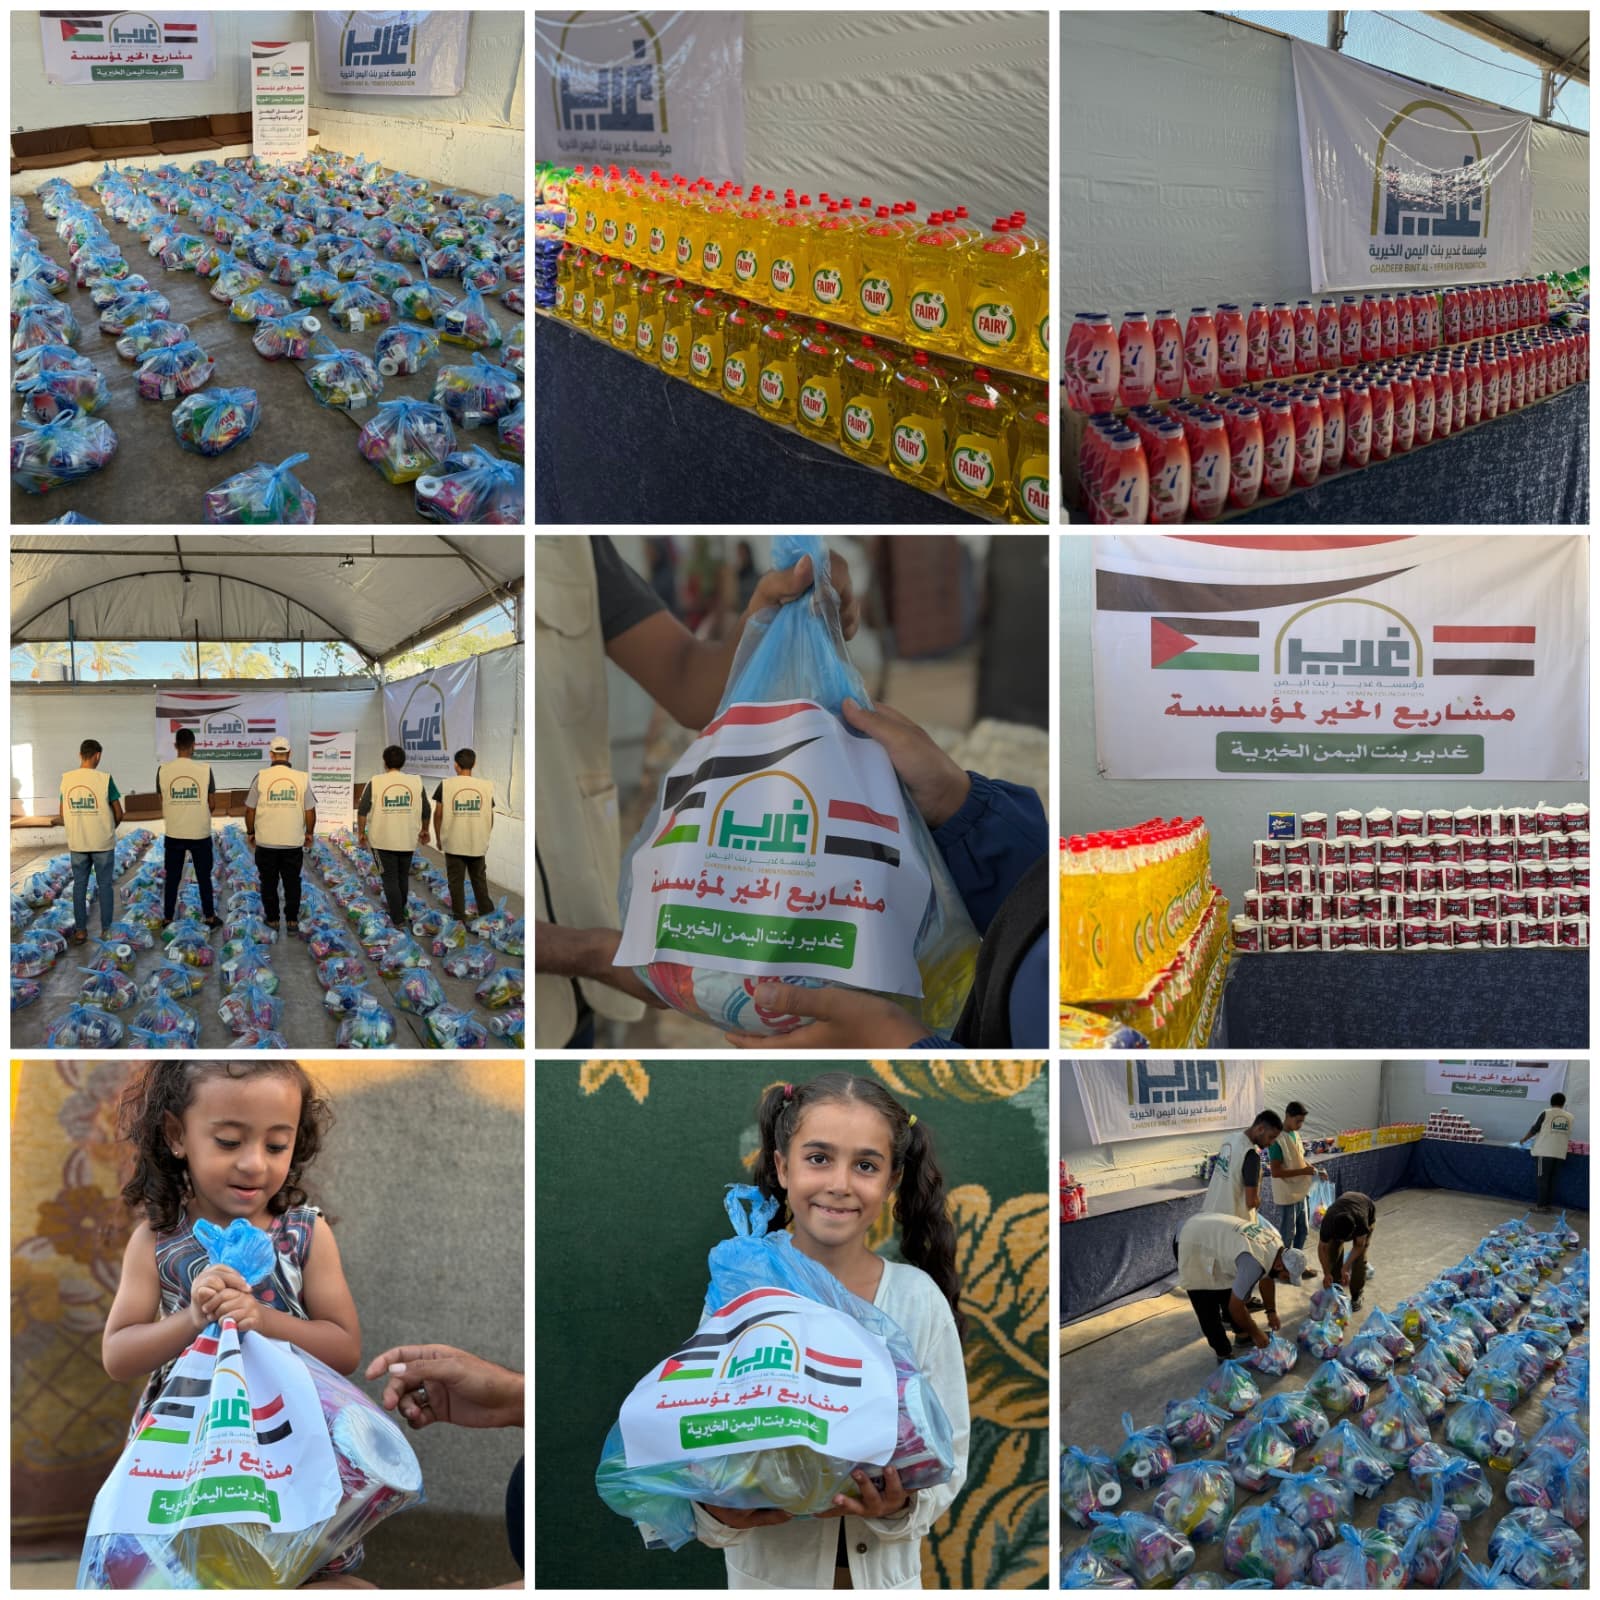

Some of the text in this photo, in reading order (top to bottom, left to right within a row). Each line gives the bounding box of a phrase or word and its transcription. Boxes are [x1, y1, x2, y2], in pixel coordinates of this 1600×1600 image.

[114, 24, 157, 43] غدير
[71, 50, 192, 63] مشاريع الخير لمؤسسة
[560, 39, 654, 132] غدير
[632, 138, 672, 157] مؤسسة
[1385, 155, 1482, 237] غدير
[704, 252, 718, 264] FAIRY
[1369, 243, 1488, 260] مؤسسة غدير بنت اليمن الخيرية
[738, 260, 752, 273] FAIRY
[1370, 263, 1404, 274] GHADEER
[1404, 264, 1420, 272] BINT
[1421, 263, 1429, 272] AL
[774, 269, 790, 284] FAIRY
[816, 279, 836, 294] FAIRY
[864, 290, 886, 306] FAIRY
[914, 302, 940, 322] FAIRY
[978, 316, 1008, 336] FAIRY
[693, 352, 706, 365] FAIRY
[726, 368, 742, 382] FAIRY
[762, 379, 778, 396] FAIRY
[803, 395, 822, 412] FAIRY
[847, 414, 868, 434] FAIRY
[898, 434, 920, 457] FAIRY
[958, 458, 986, 481] FAIRY
[1288, 626, 1410, 677] غدير
[1274, 680, 1424, 690] مؤسسة غدير بنت اليمن
[1164, 693, 1516, 729] مشاريع الخير لمؤسسة
[208, 720, 242, 734] غدير
[402, 702, 442, 750] غدير
[216, 739, 234, 748] الخير
[1231, 741, 1470, 764] غدير بنت اليمن الخيرية
[172, 784, 198, 799] غدير
[270, 786, 295, 800] غدير
[384, 792, 410, 807] غدير
[454, 796, 480, 810] غدير
[718, 799, 808, 854] غدير
[780, 858, 816, 868] مؤسسة
[730, 876, 780, 904] الخير
[786, 880, 886, 913] مشاريع
[662, 914, 844, 950] غدير بنت اليمن الخيرية
[1440, 1070, 1540, 1084] مشاريع الخير لمؤسسة
[1130, 1108, 1154, 1120] الخيرية
[1156, 1108, 1176, 1118] اليمن
[1190, 1106, 1202, 1117] غدير
[1204, 1104, 1227, 1114] مؤسسة
[728, 1340, 793, 1378] غدير
[656, 1384, 849, 1413] مشاريع الخير لمؤسسة
[688, 1416, 820, 1440] غدير بنت اليمن الخيرية
[224, 1486, 248, 1500] بنت
